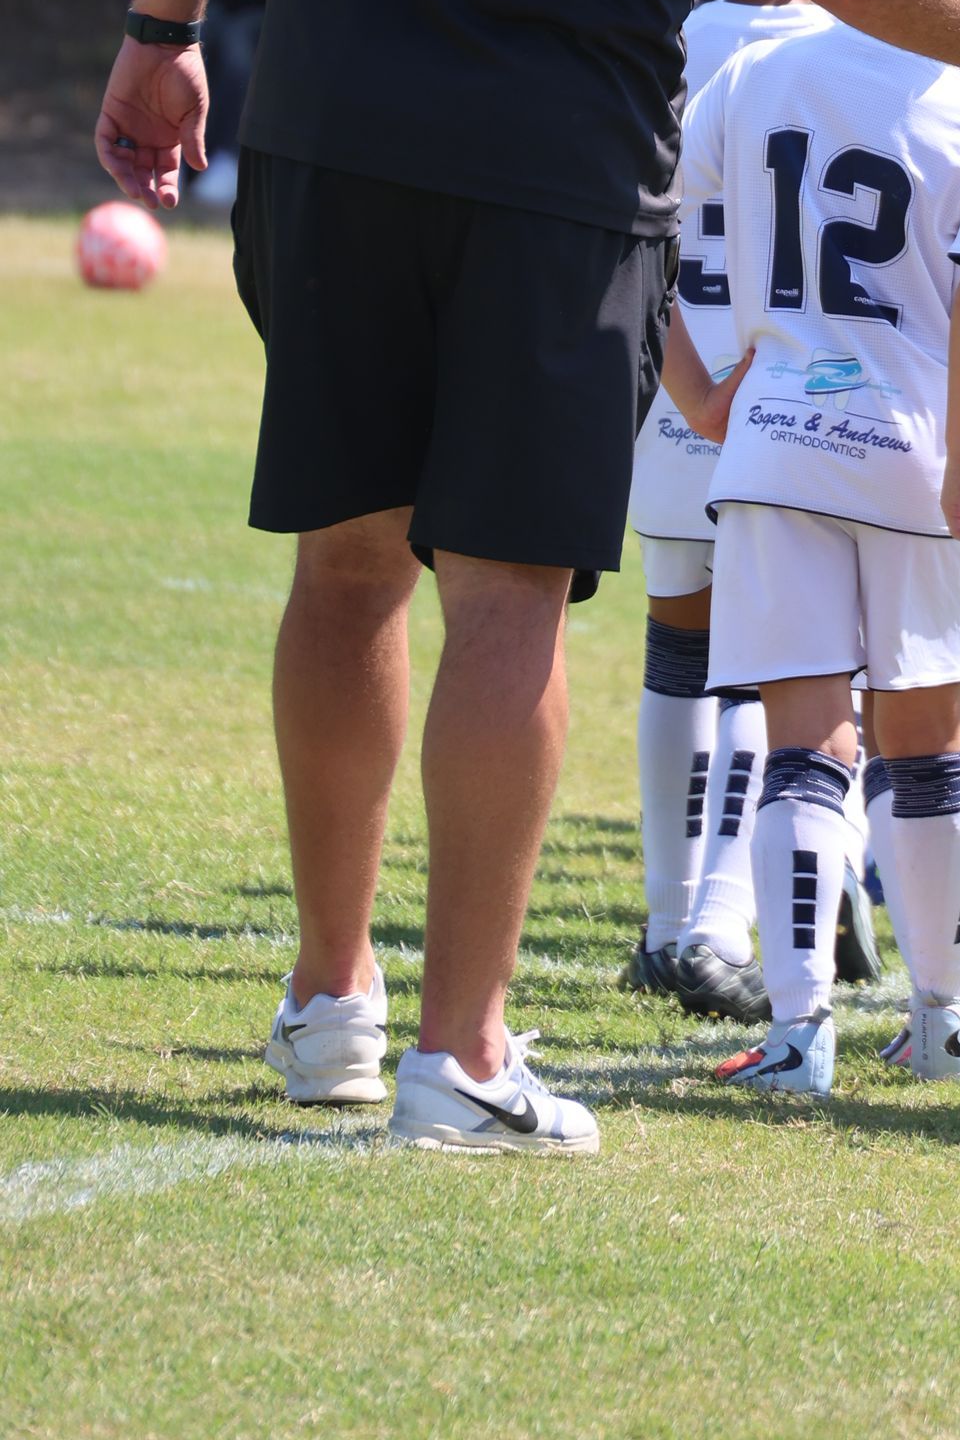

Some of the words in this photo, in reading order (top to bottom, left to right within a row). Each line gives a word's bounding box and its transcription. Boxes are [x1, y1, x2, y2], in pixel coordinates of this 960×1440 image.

[764, 125, 915, 328] 12
[745, 405, 797, 432] Rogers
[804, 413, 822, 432] &
[825, 419, 912, 453] Andrews
[770, 429, 866, 460] ORTHODONTICS
